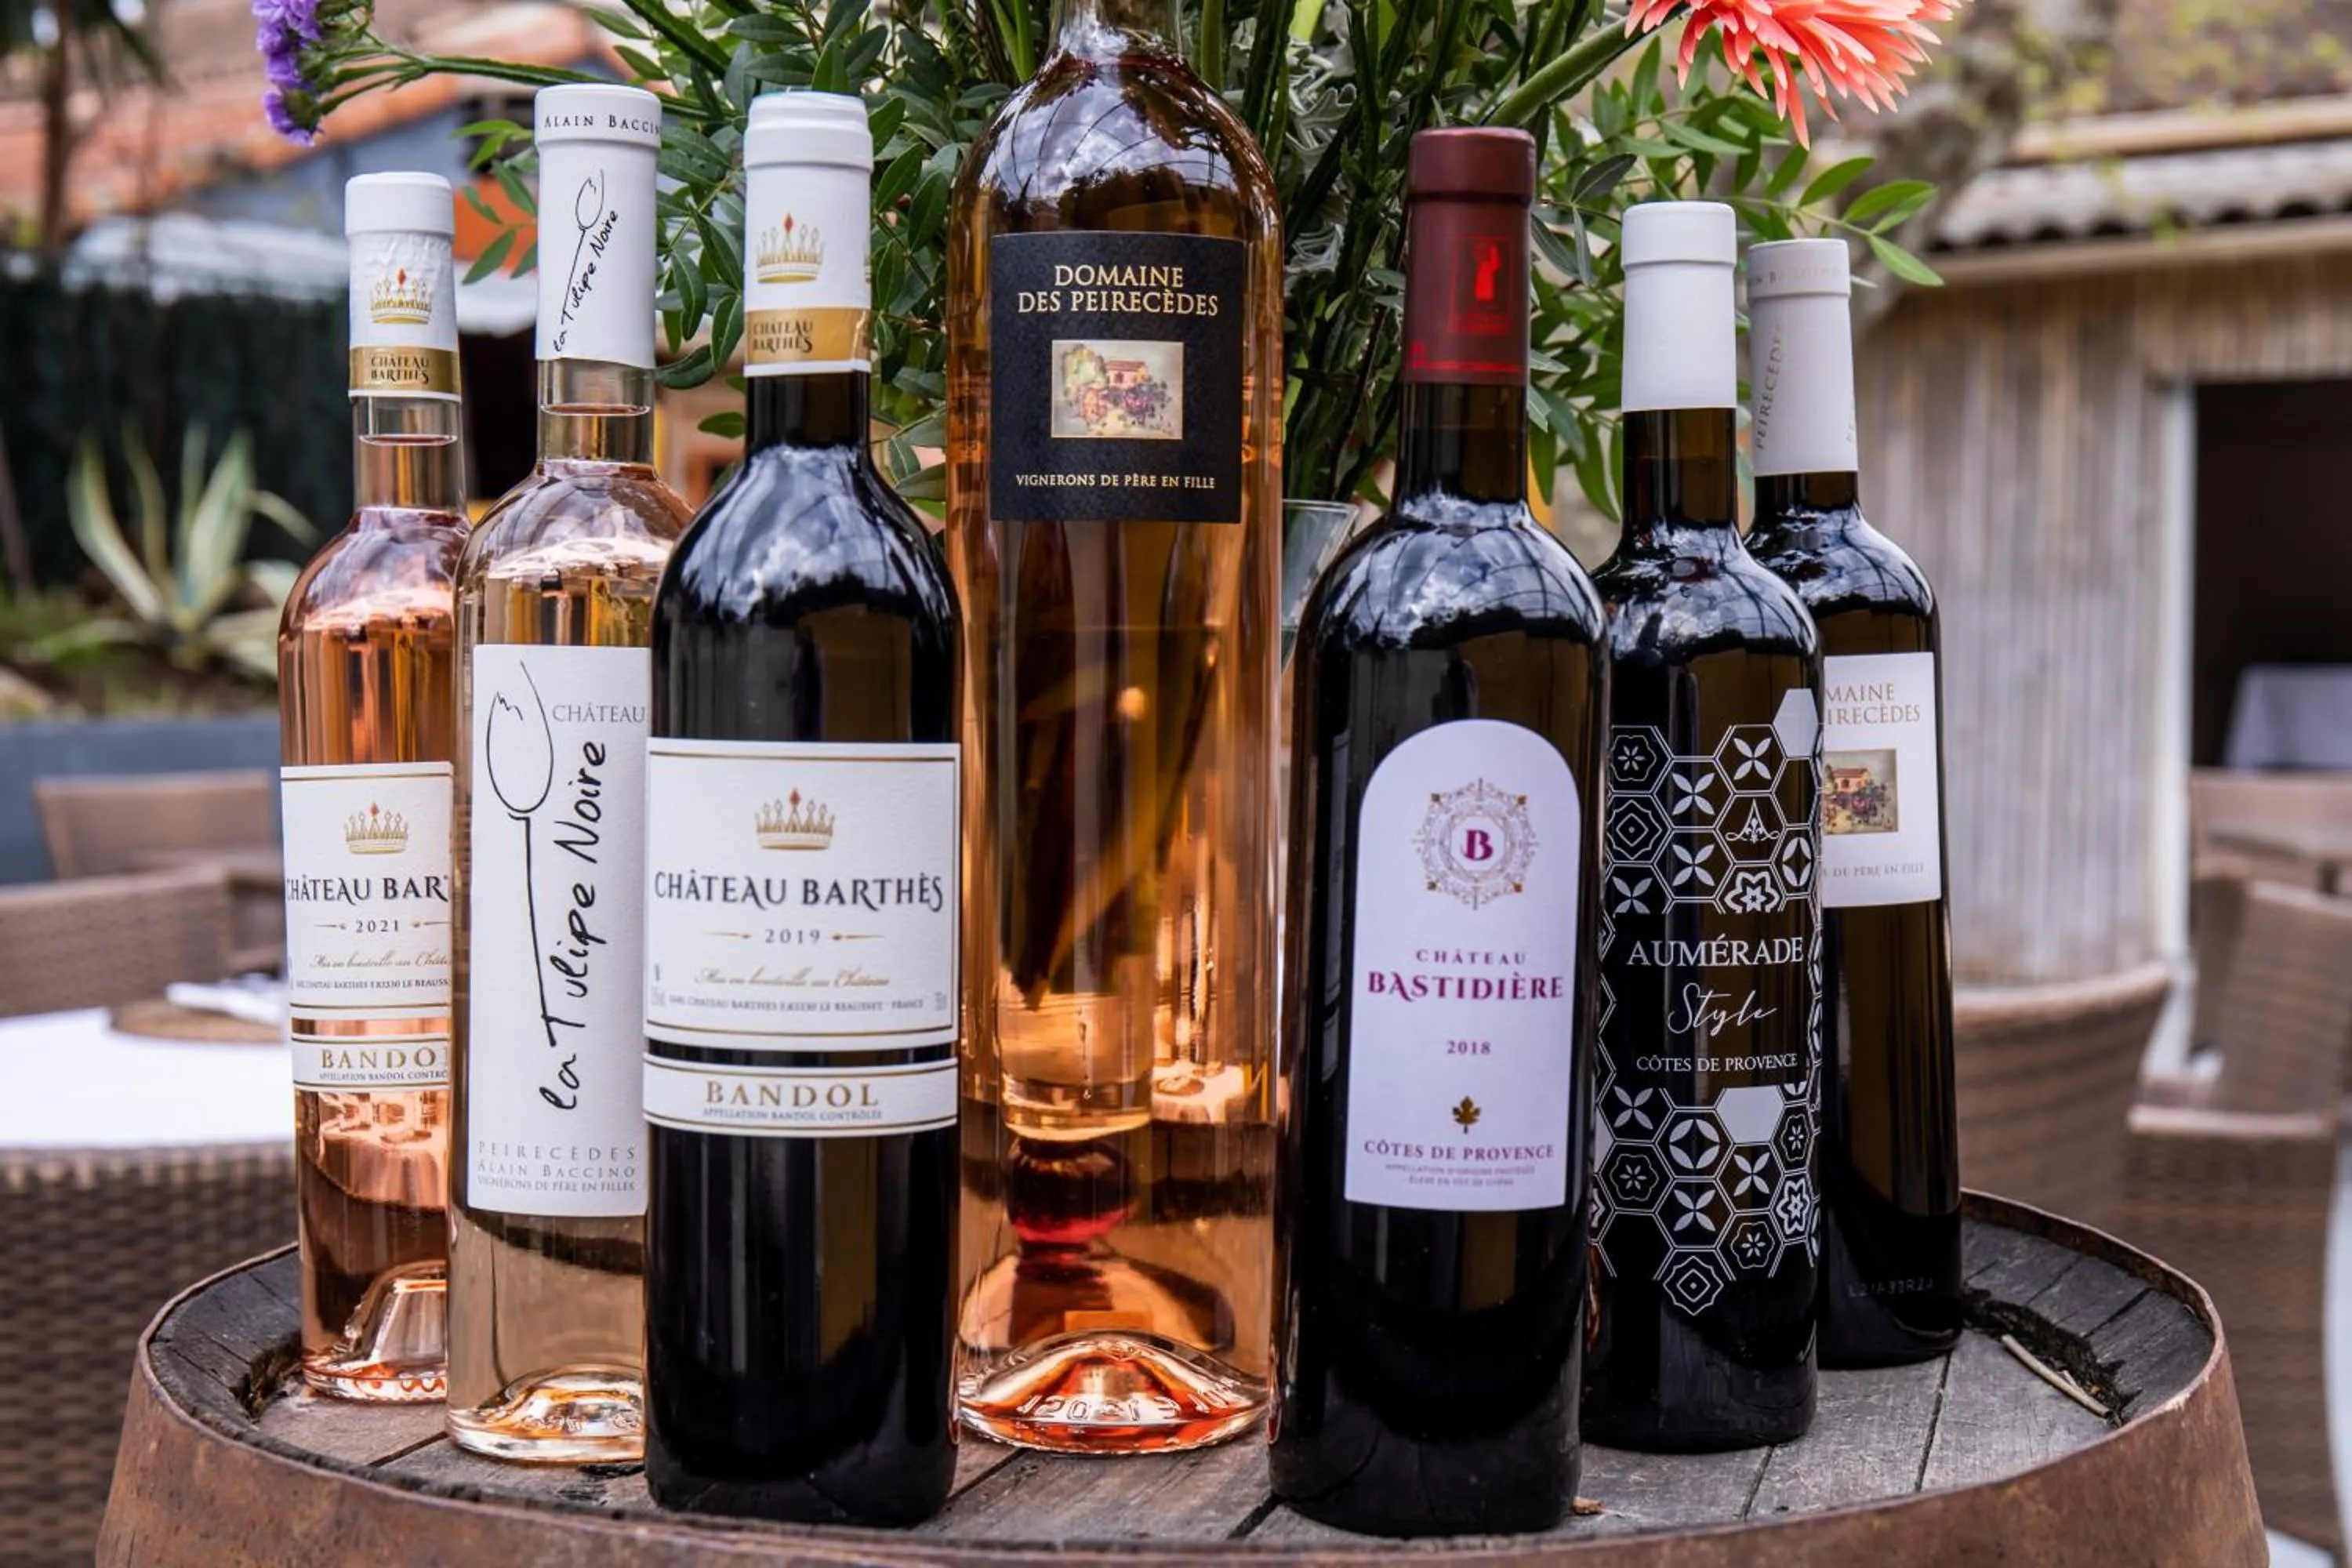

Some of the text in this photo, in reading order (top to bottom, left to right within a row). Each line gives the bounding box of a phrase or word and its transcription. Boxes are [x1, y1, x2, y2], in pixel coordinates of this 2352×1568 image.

[544, 115, 593, 128] ALAIN
[561, 263, 597, 325] Tulipe
[590, 210, 619, 259] Noire
[1054, 265, 1184, 288] DOMAINE
[1018, 289, 1218, 316] DES PEIRECÈDES
[1016, 473, 1215, 489] VIGNERONS DE PÈRE EN FILLE
[1824, 683, 1895, 702] MAINE
[552, 702, 646, 723] CHÂTEAU
[1828, 702, 1920, 725] IRECÈDES
[1461, 829, 1494, 862] B
[383, 876, 450, 902] BAR
[655, 869, 943, 913] CHÂTEAU BARTHÈS
[355, 920, 400, 933] 2021
[539, 741, 607, 1109] la Tulipe Noire
[764, 928, 822, 945] 2019
[1416, 949, 1526, 965] CHÂTEAU
[1627, 933, 1803, 967] AUMÉRADE
[1368, 971, 1564, 1003] BASTIDIÈRE
[1668, 982, 1777, 1036] Style
[1447, 1040, 1491, 1055] 2018
[1636, 1053, 1797, 1072] CÔTES DE PROVENCE
[706, 1080, 879, 1108] BANDOL
[479, 1141, 635, 1162] PEIRECEDES
[1364, 1139, 1554, 1161] CÔTES DE PROVENCE
[477, 1159, 635, 1178] ALAIN BACCINO
[535, 1181, 549, 1191] DE
[581, 1181, 597, 1192] EN
